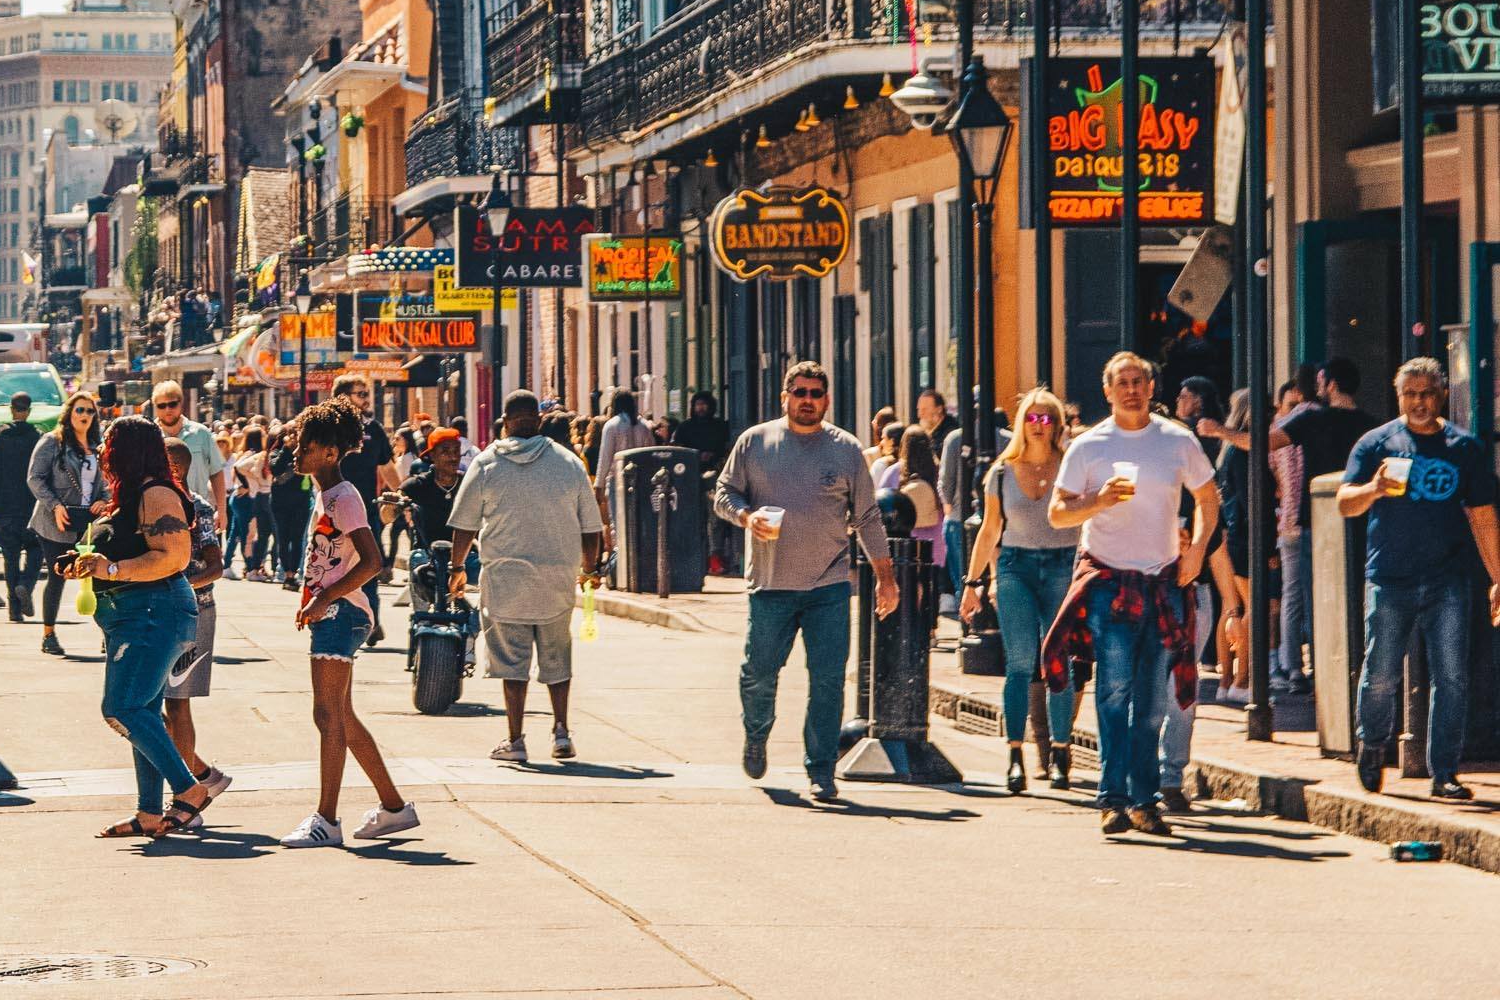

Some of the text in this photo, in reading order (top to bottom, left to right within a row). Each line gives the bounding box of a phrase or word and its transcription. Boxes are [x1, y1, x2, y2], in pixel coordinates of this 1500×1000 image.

[1049, 105, 1107, 150] BIG
[473, 235, 583, 252] SUTR
[724, 222, 843, 249] BANDSTAND
[362, 320, 476, 346] BARELY LEGAL CLUB
